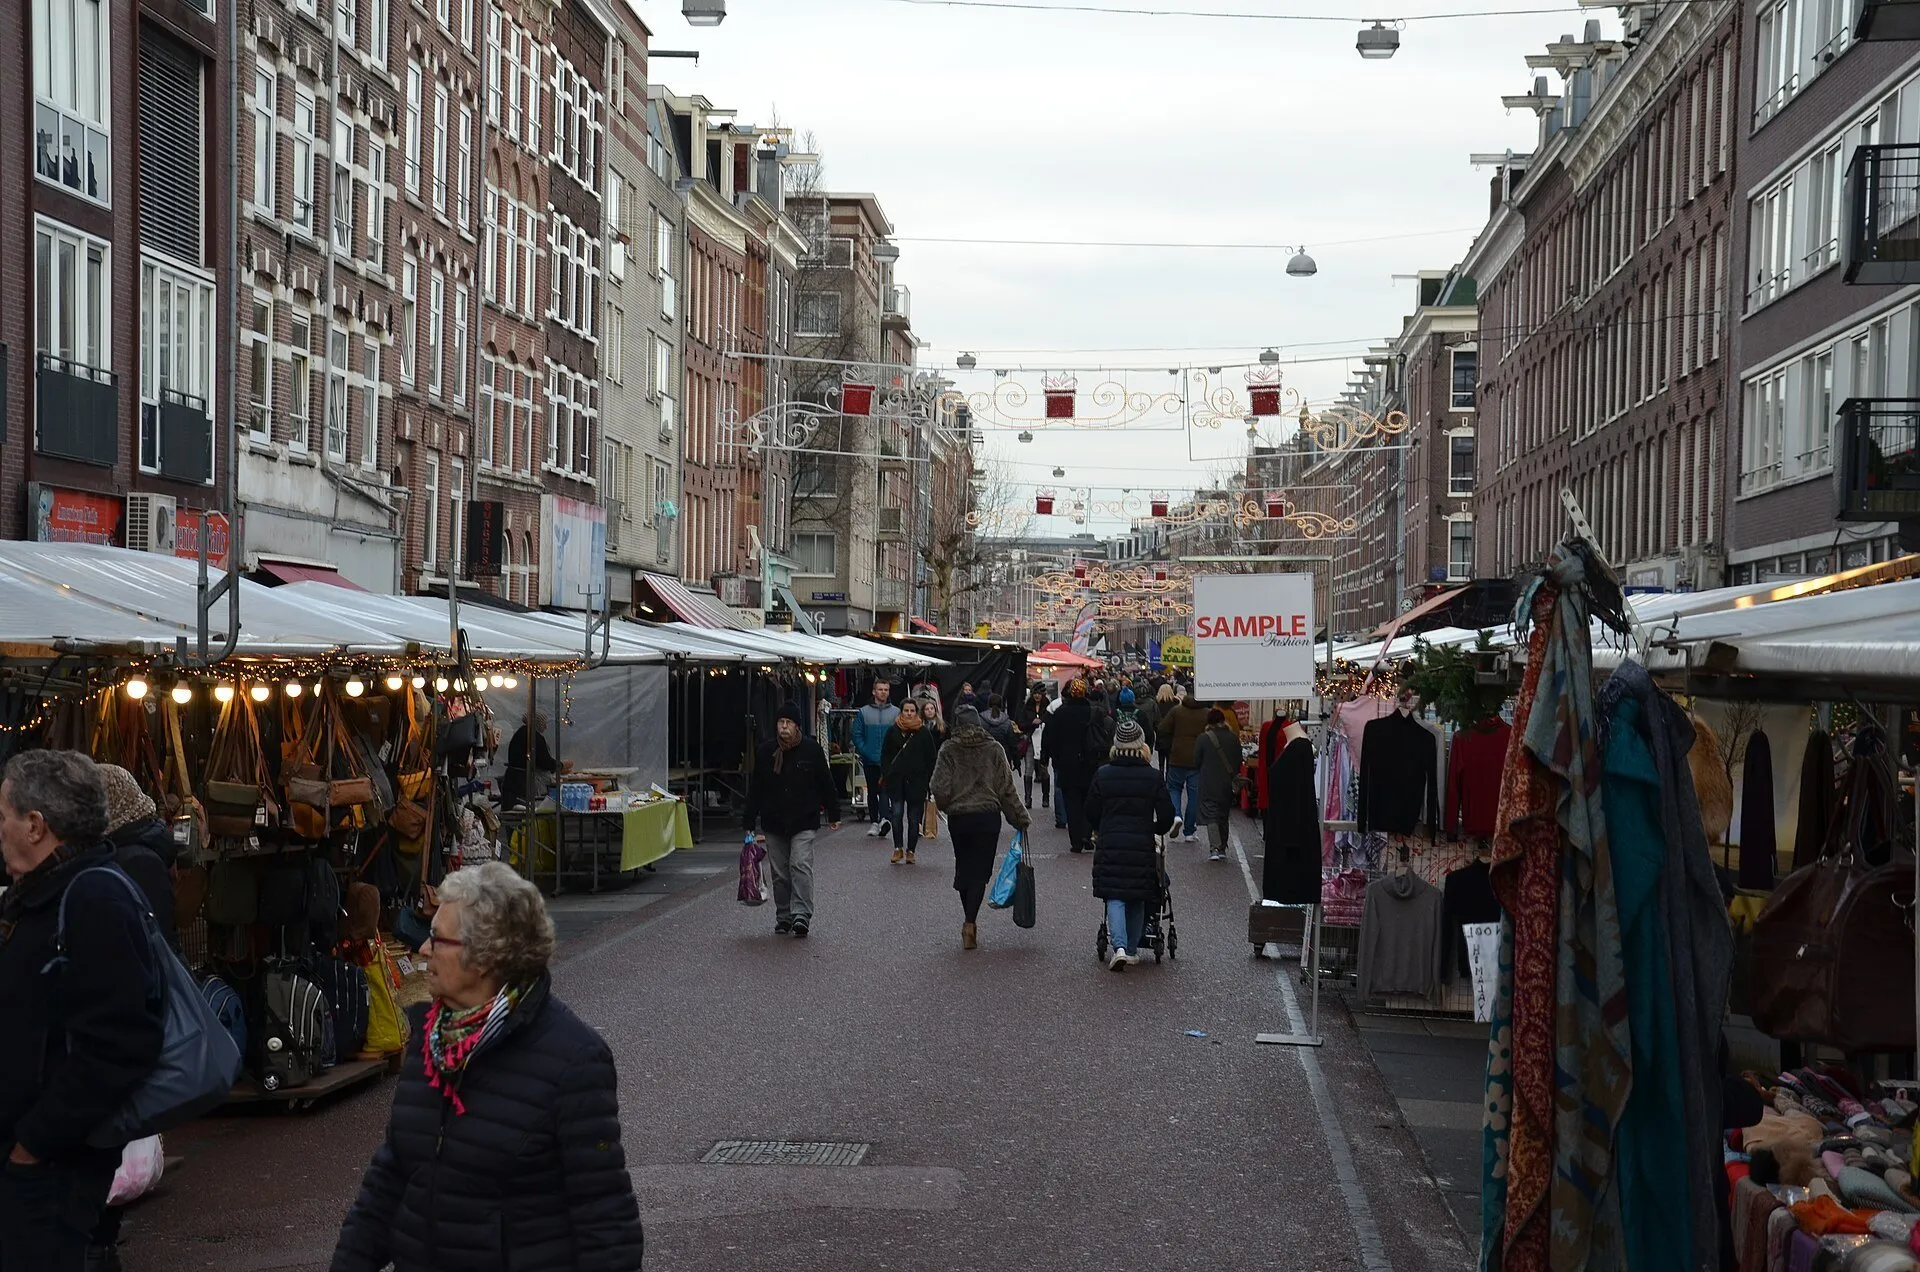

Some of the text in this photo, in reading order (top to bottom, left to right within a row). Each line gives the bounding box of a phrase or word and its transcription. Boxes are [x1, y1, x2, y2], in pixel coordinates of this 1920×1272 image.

[482, 502, 491, 566] BURGERS
[1197, 615, 1306, 638] SAMPLE
[1261, 632, 1310, 647] Fashion
[1167, 646, 1190, 654] Johan
